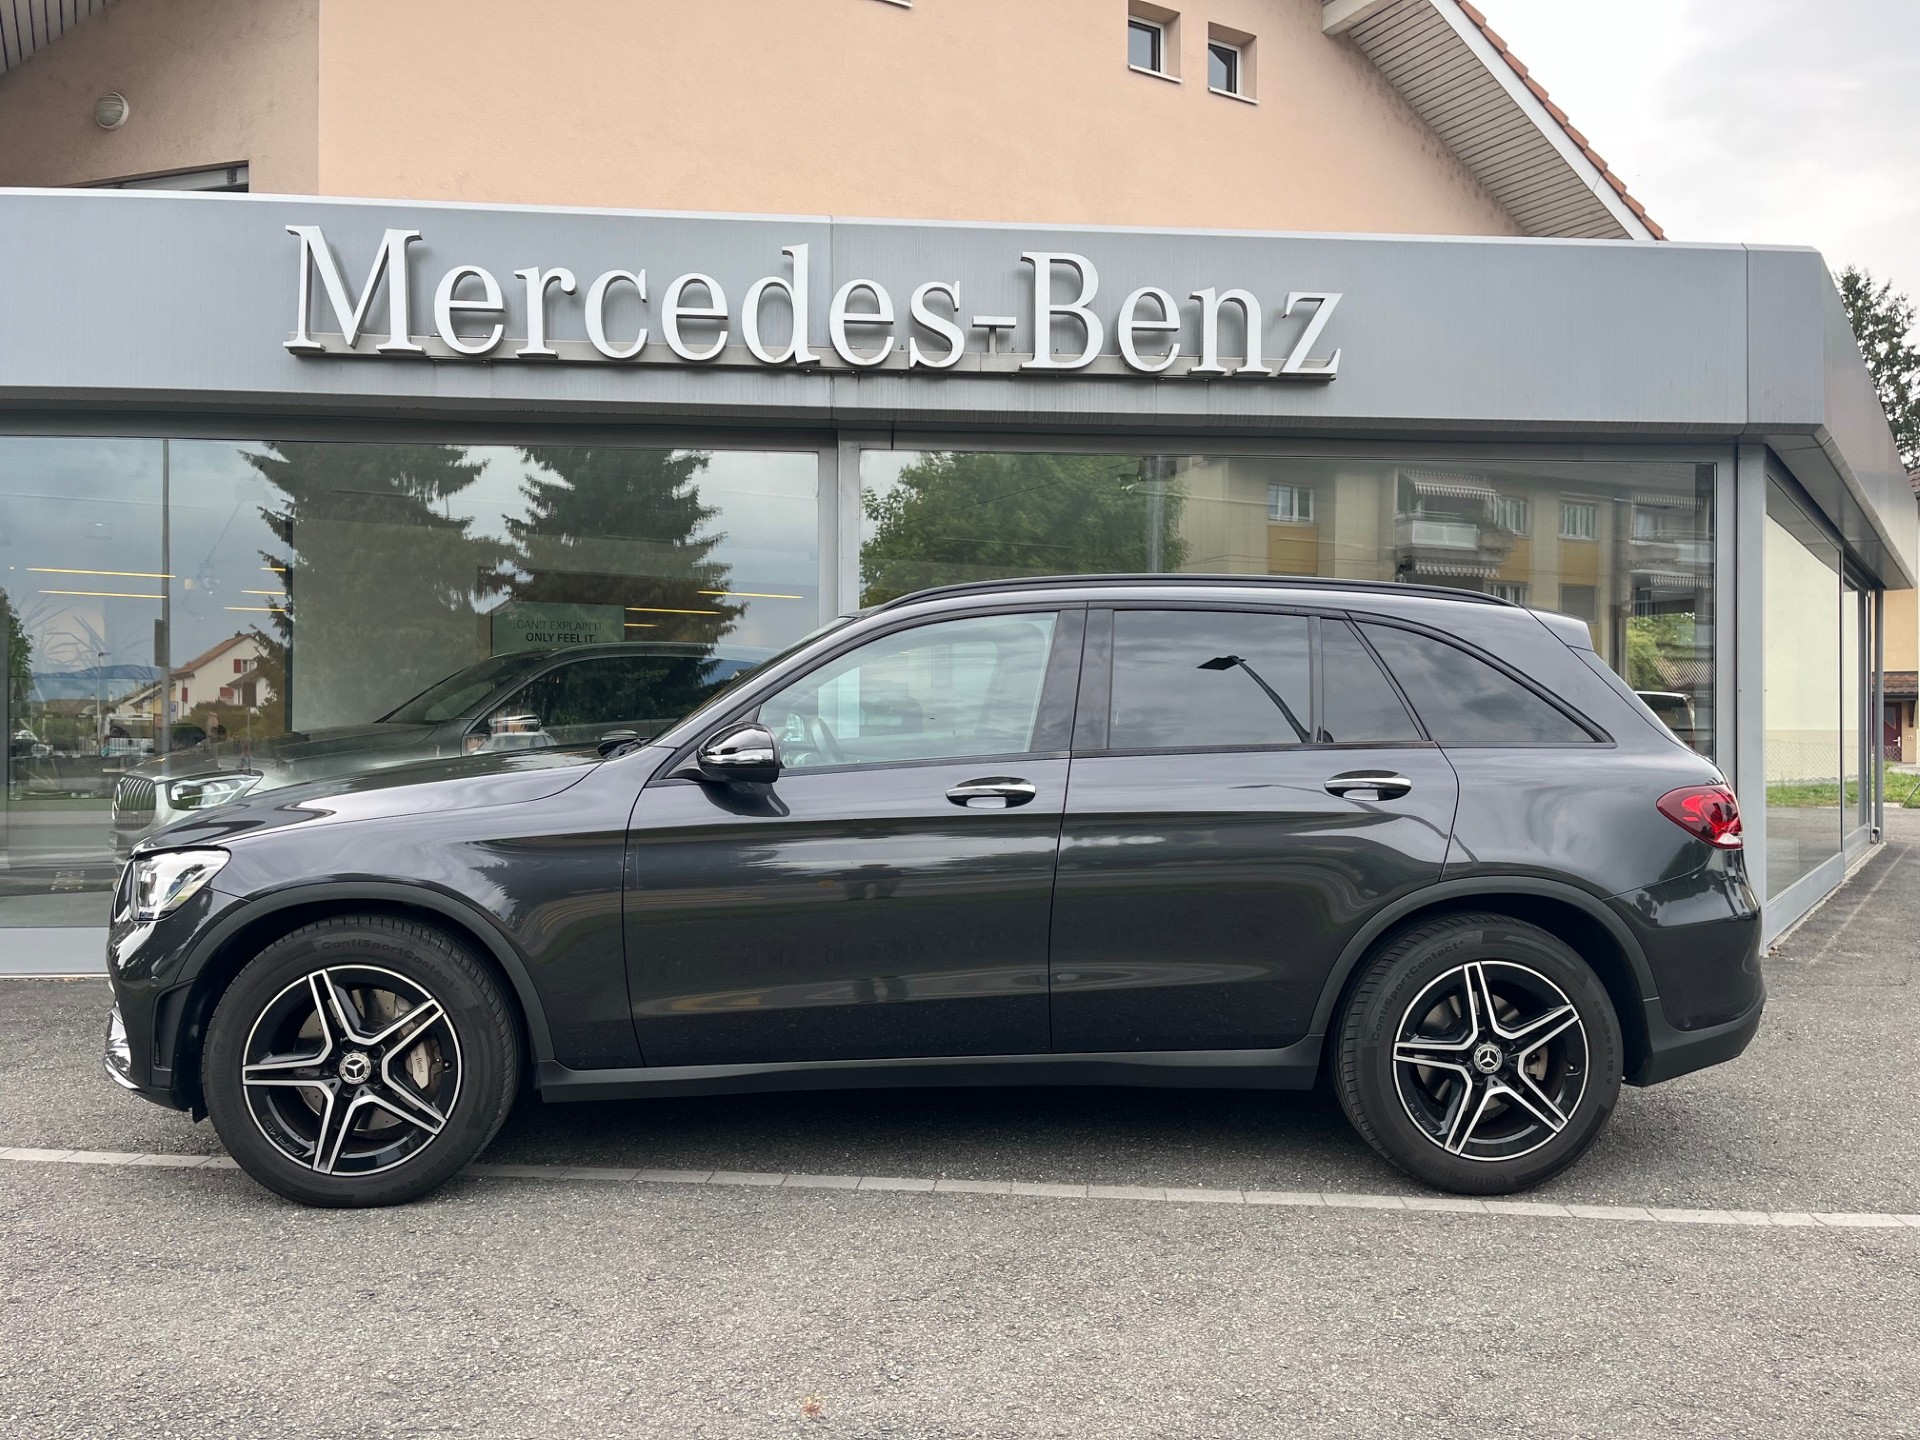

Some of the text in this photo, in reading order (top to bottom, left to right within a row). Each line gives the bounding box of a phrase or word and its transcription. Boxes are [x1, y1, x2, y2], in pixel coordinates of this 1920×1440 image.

[283, 224, 1343, 377] Mercedes-Benz
[517, 619, 547, 630] CAN'T
[550, 620, 591, 631] EXPLAIN
[525, 632, 555, 642] ONLY
[557, 633, 582, 643] FEEL
